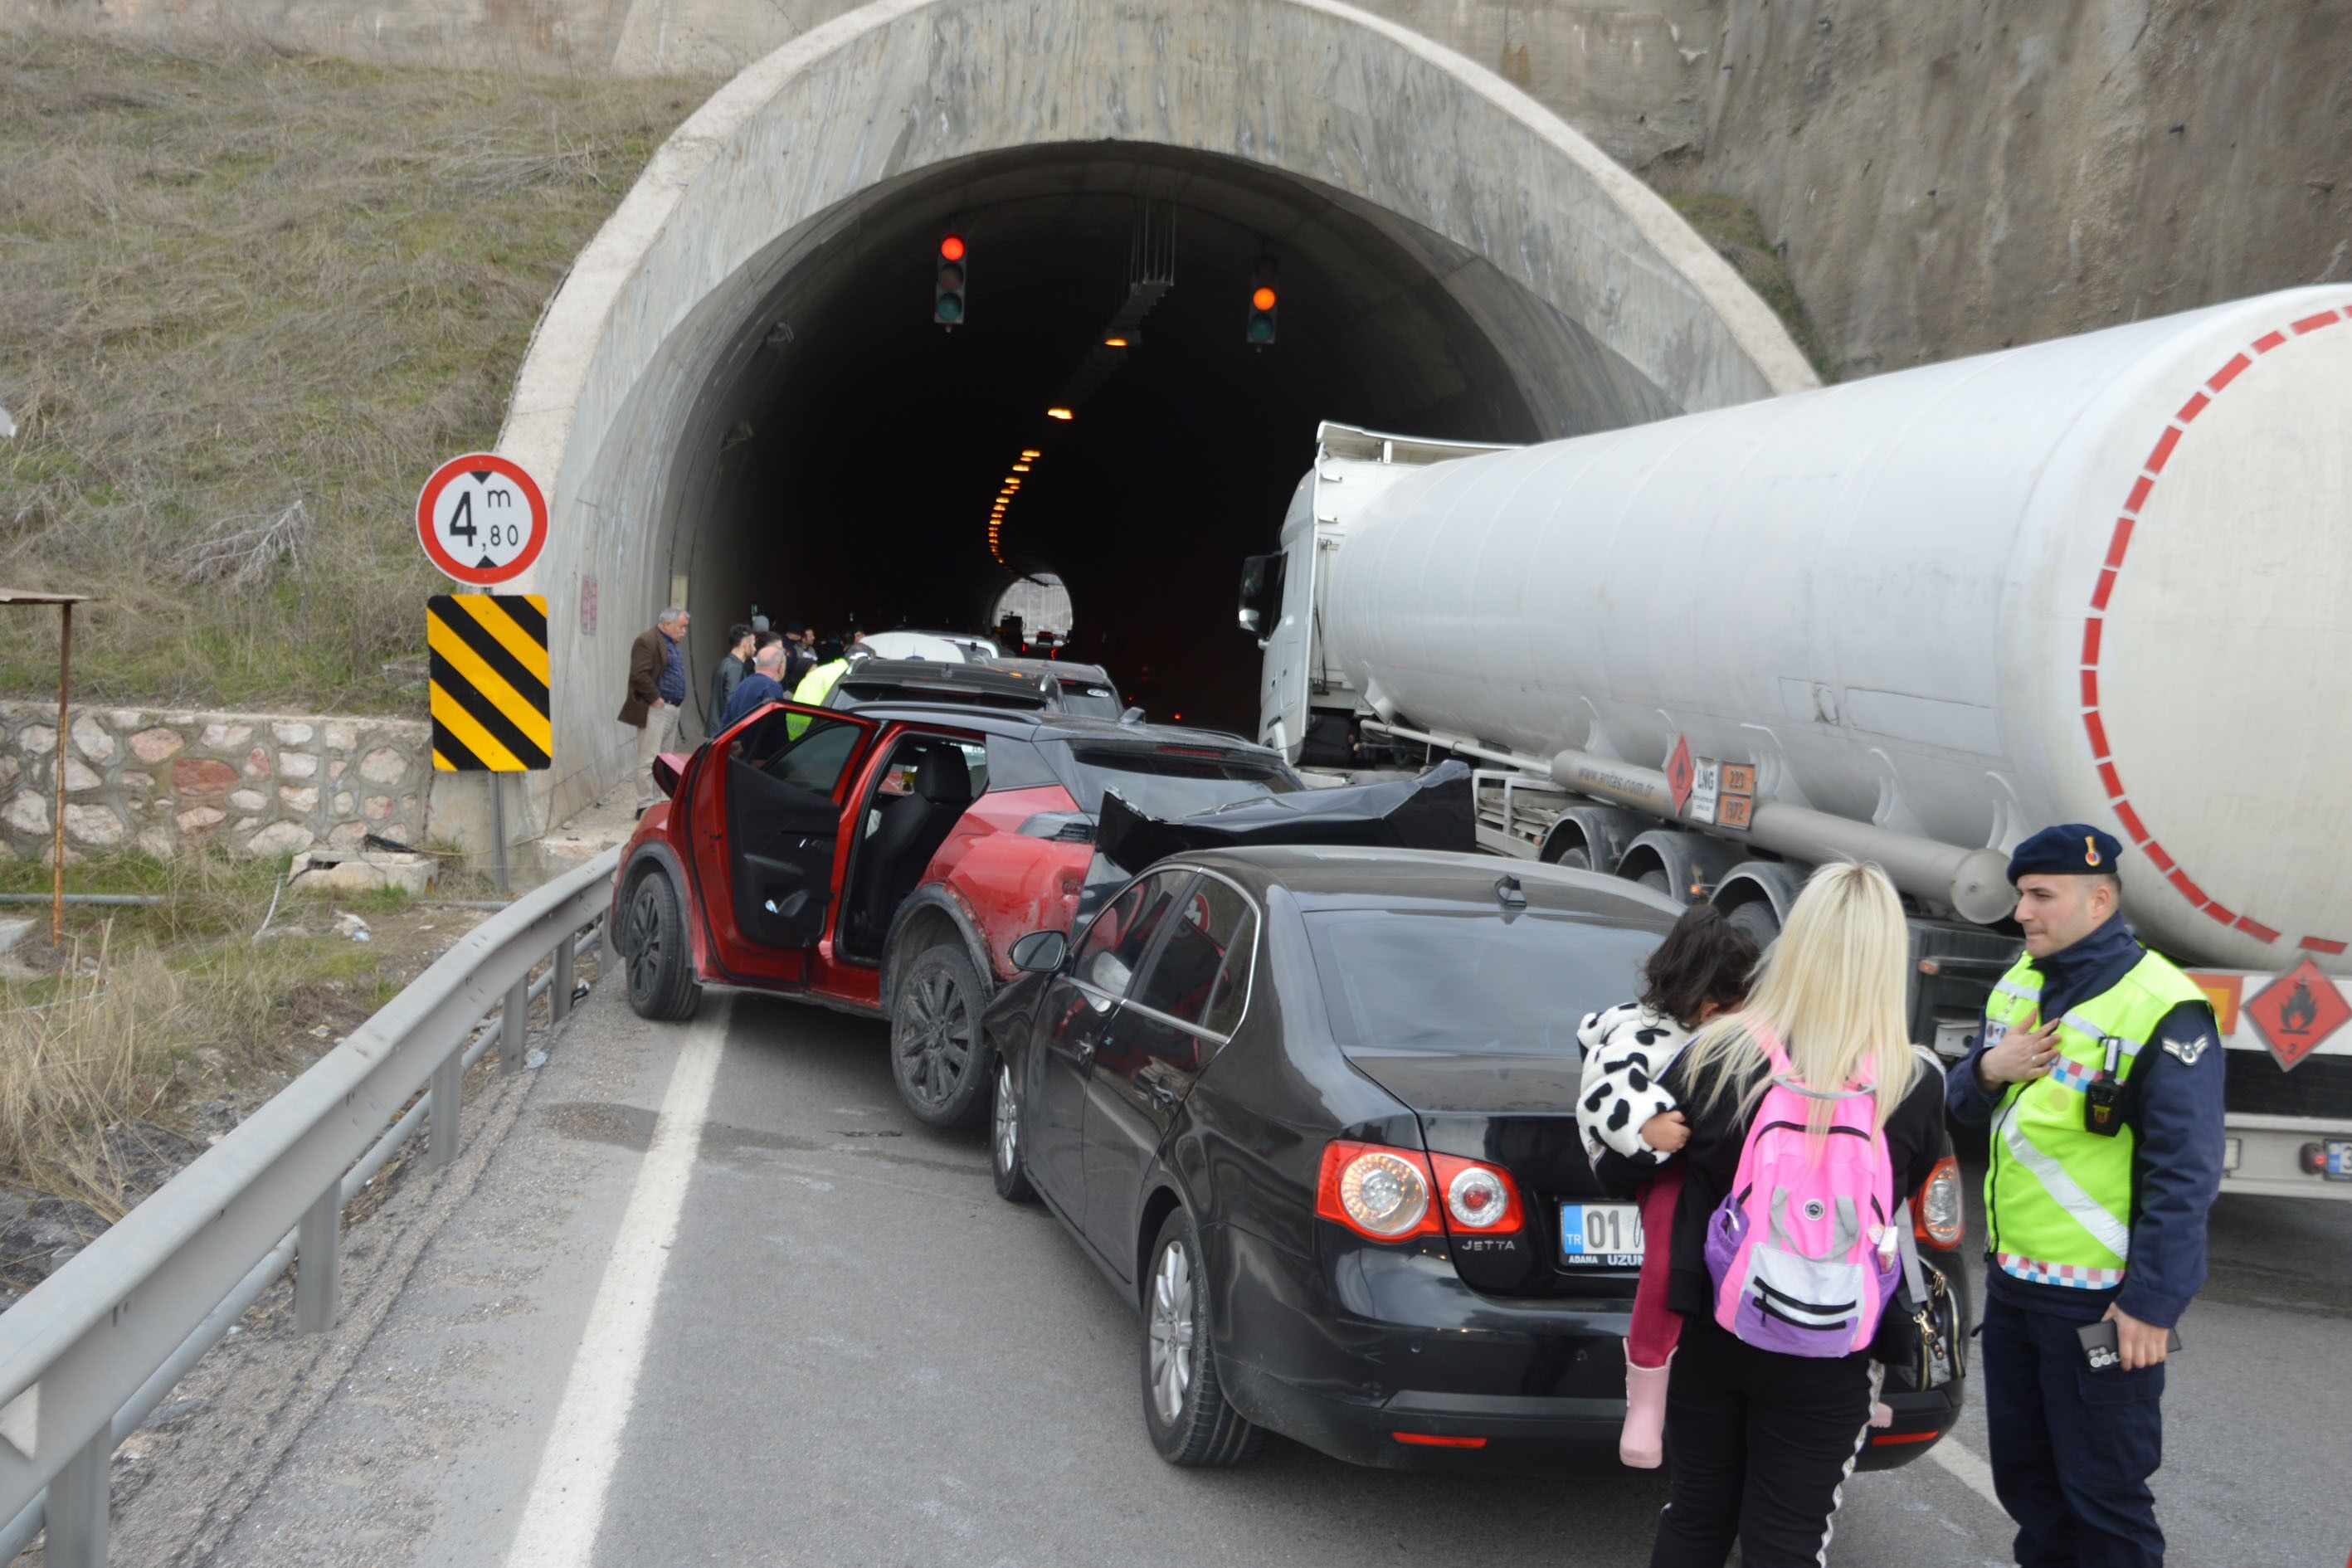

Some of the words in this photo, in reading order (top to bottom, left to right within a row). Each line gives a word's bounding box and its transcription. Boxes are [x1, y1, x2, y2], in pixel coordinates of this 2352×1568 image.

[450, 491, 476, 547] 4
[487, 489, 511, 508] m
[1697, 769, 1714, 791] LNG
[1729, 769, 1746, 789] 223
[2290, 1043, 2297, 1054] 2
[1462, 1239, 1516, 1251] JETTA
[1566, 1234, 1581, 1245] TR
[1569, 1254, 1598, 1264] ADANA
